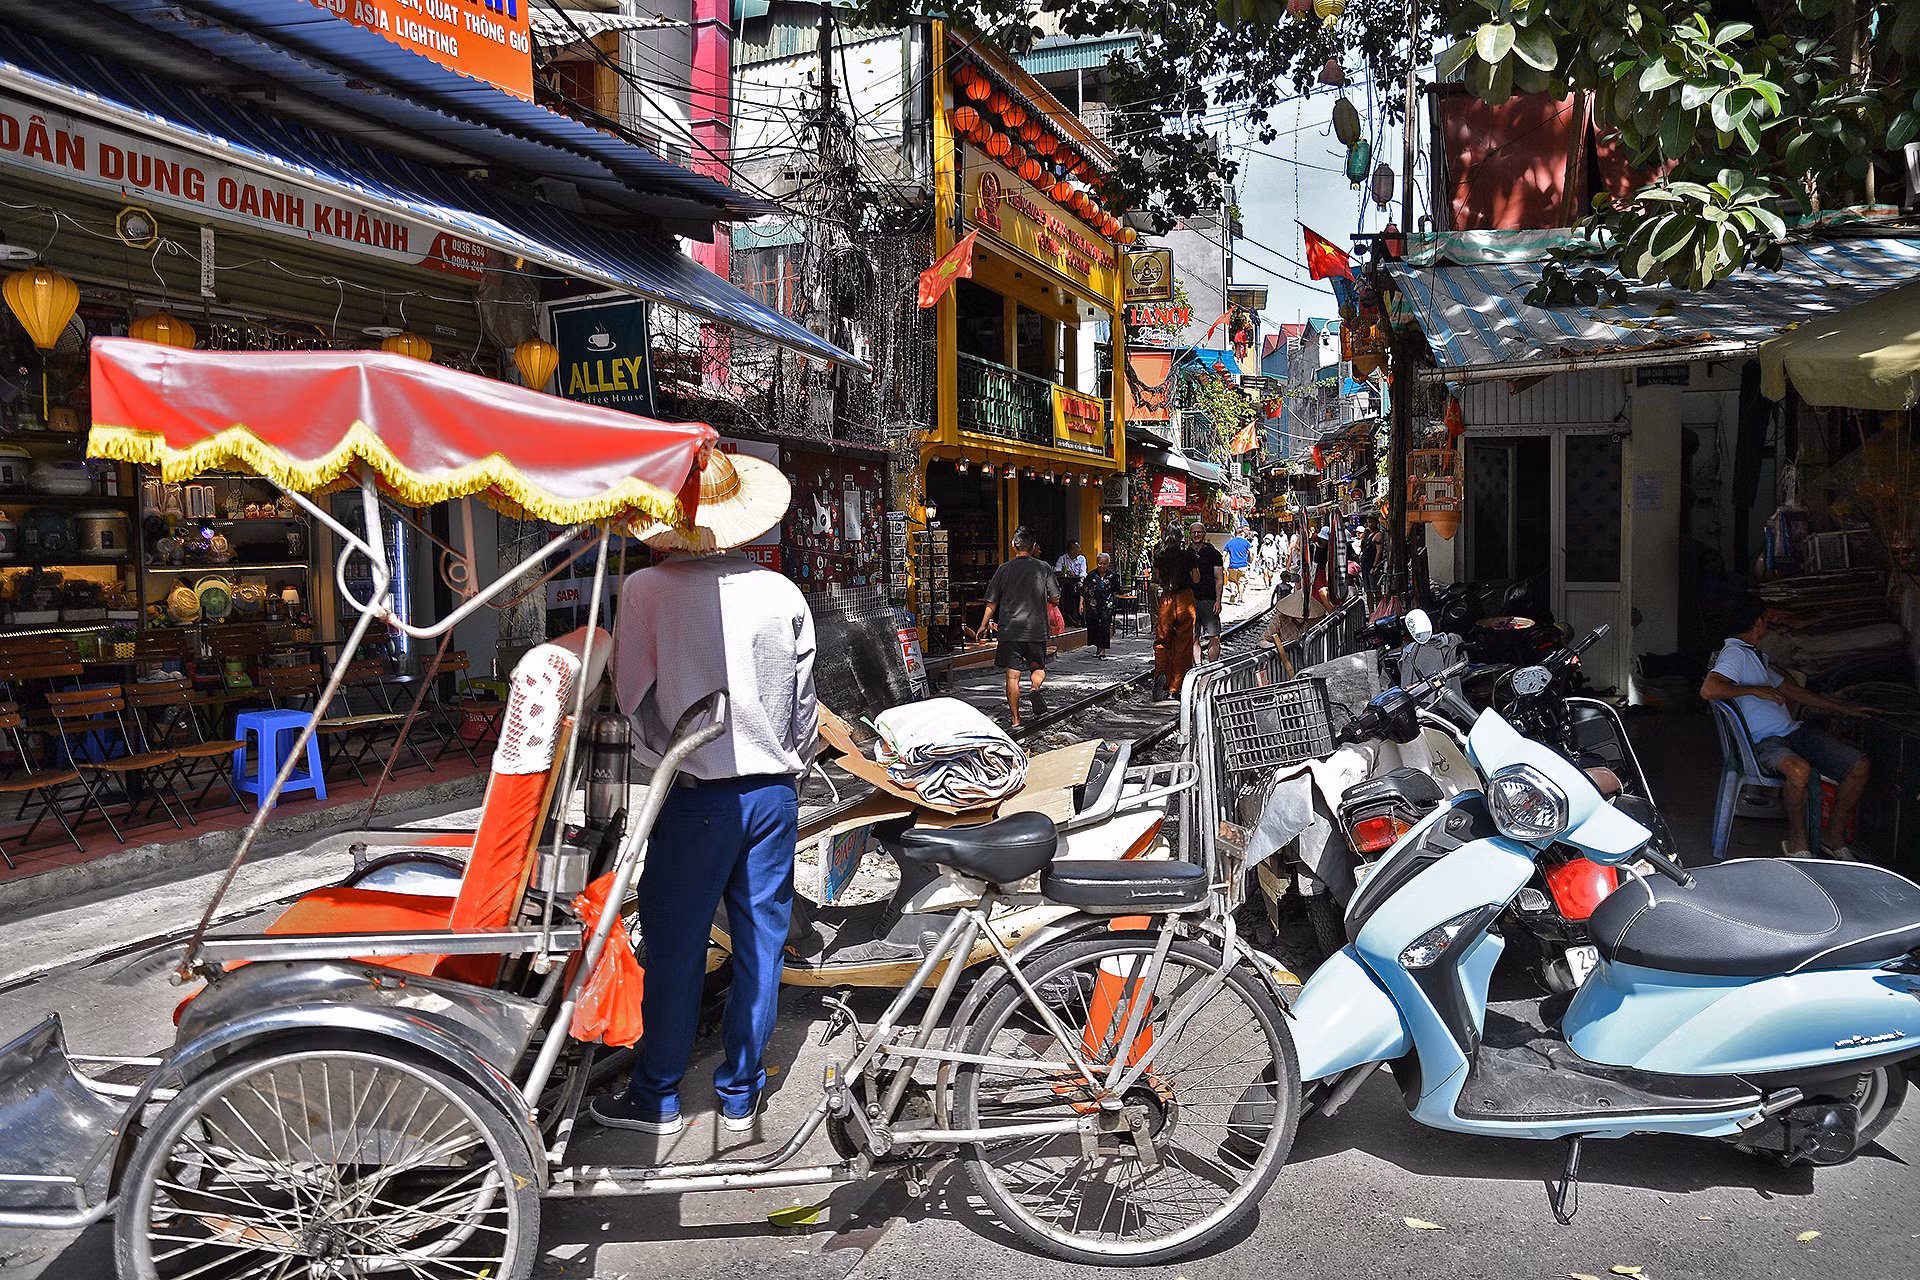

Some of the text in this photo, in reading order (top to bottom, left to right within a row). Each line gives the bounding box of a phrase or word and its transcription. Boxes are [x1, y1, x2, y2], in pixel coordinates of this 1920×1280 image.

[354, 0, 390, 31] ASIA
[396, 15, 458, 57] LIGHTING
[464, 10, 506, 45] THÔNG
[510, 30, 529, 54] GIÓ
[0, 112, 86, 172] DÂN
[218, 176, 304, 228] OANH
[314, 203, 409, 252] KHÁNH
[452, 239, 471, 254] 0936
[569, 356, 643, 395] ALLEY
[612, 393, 644, 403] House
[556, 588, 580, 602] SAPA
